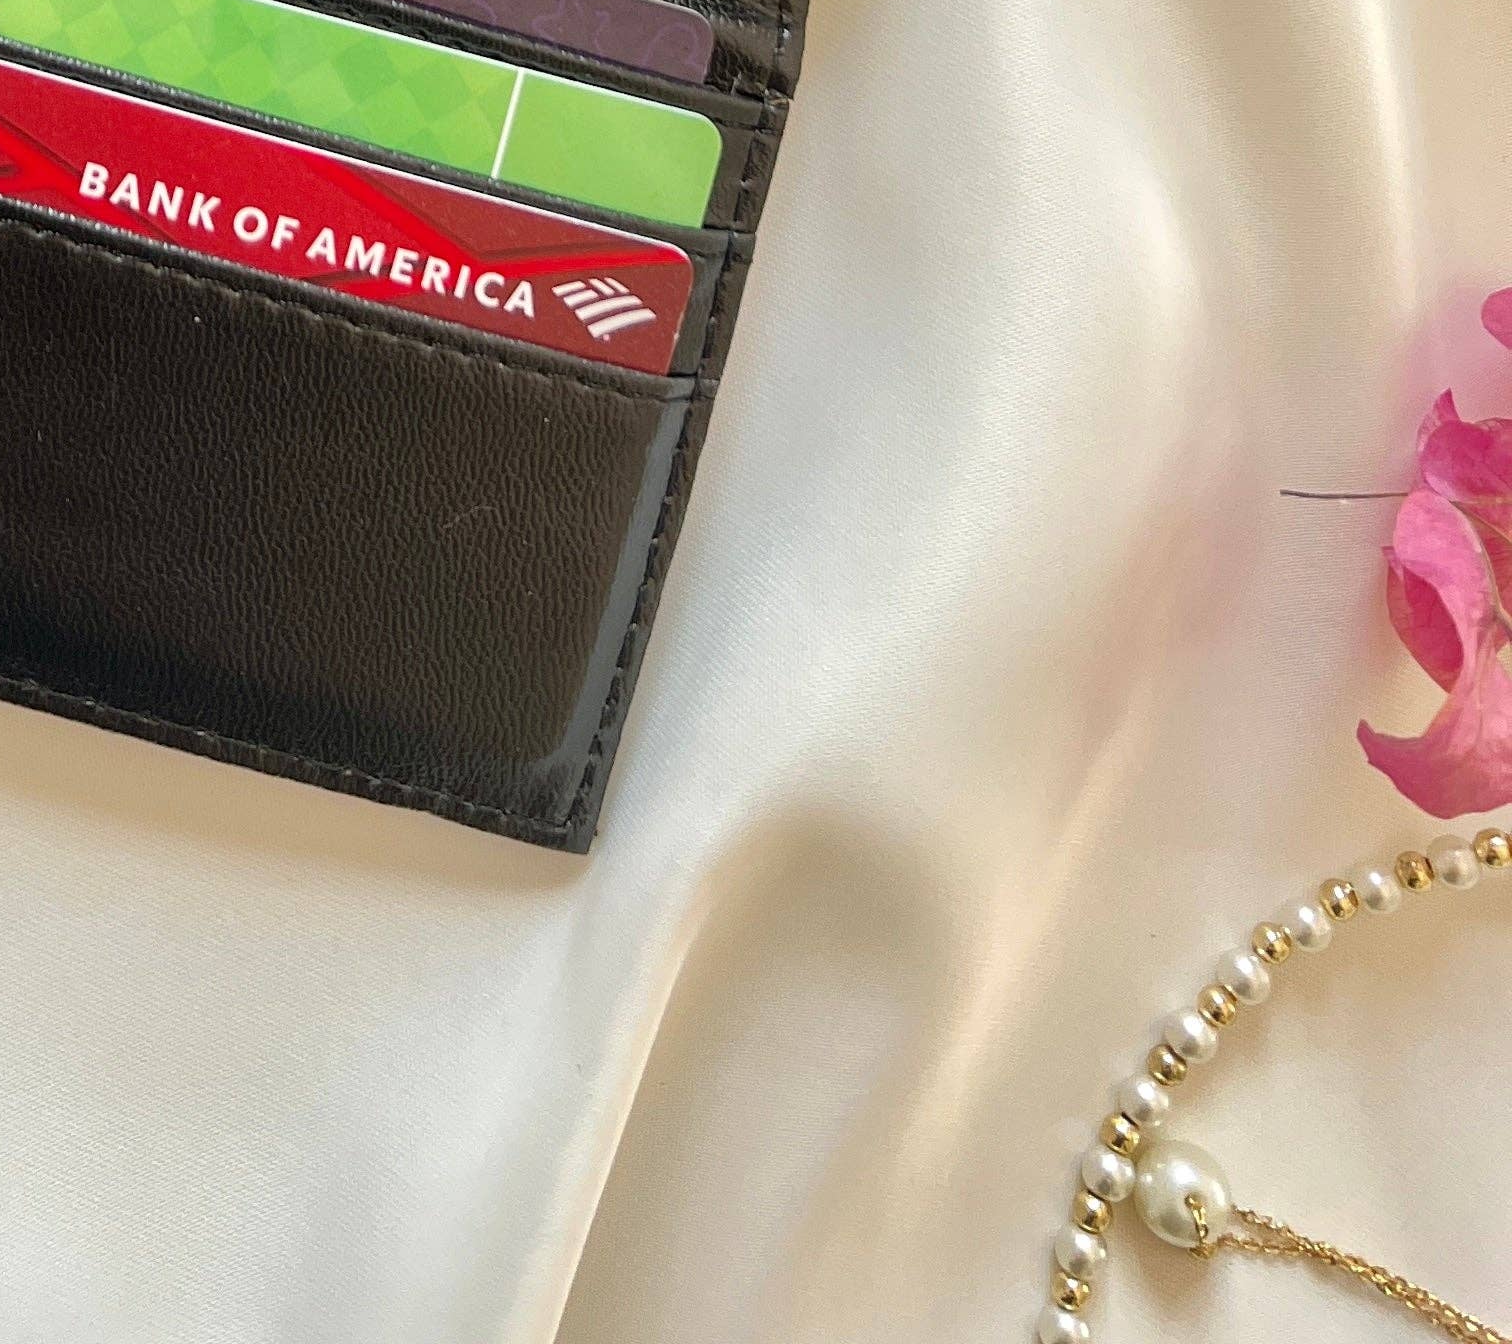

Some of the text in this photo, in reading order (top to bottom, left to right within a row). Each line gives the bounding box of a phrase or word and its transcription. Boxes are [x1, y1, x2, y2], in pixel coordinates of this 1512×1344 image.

[77, 161, 536, 319] BANK OF AMERICA
